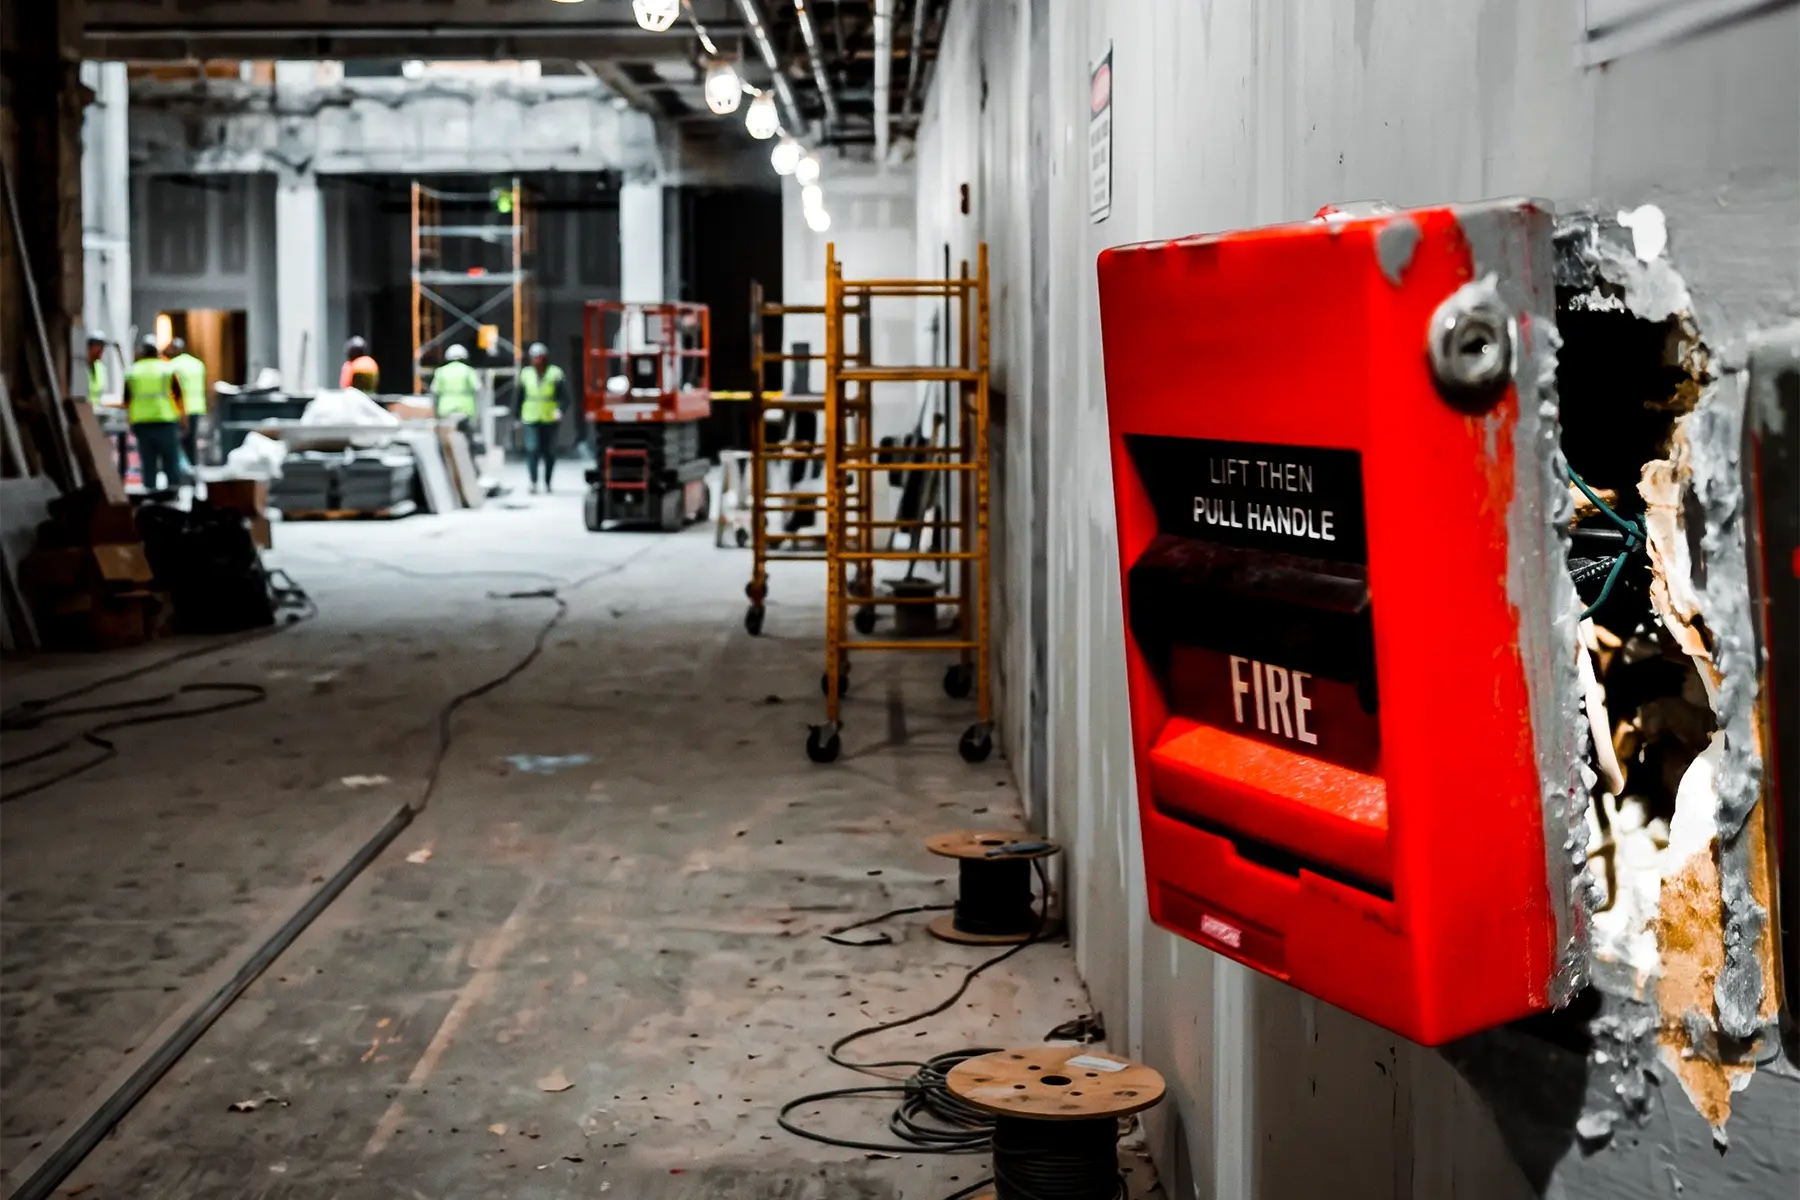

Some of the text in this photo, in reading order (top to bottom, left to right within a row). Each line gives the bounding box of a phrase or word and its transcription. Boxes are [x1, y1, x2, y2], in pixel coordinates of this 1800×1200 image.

[1209, 457, 1313, 493] LIFT THEN
[1193, 496, 1335, 541] PULL HANDLE
[1230, 655, 1317, 745] FIRE
